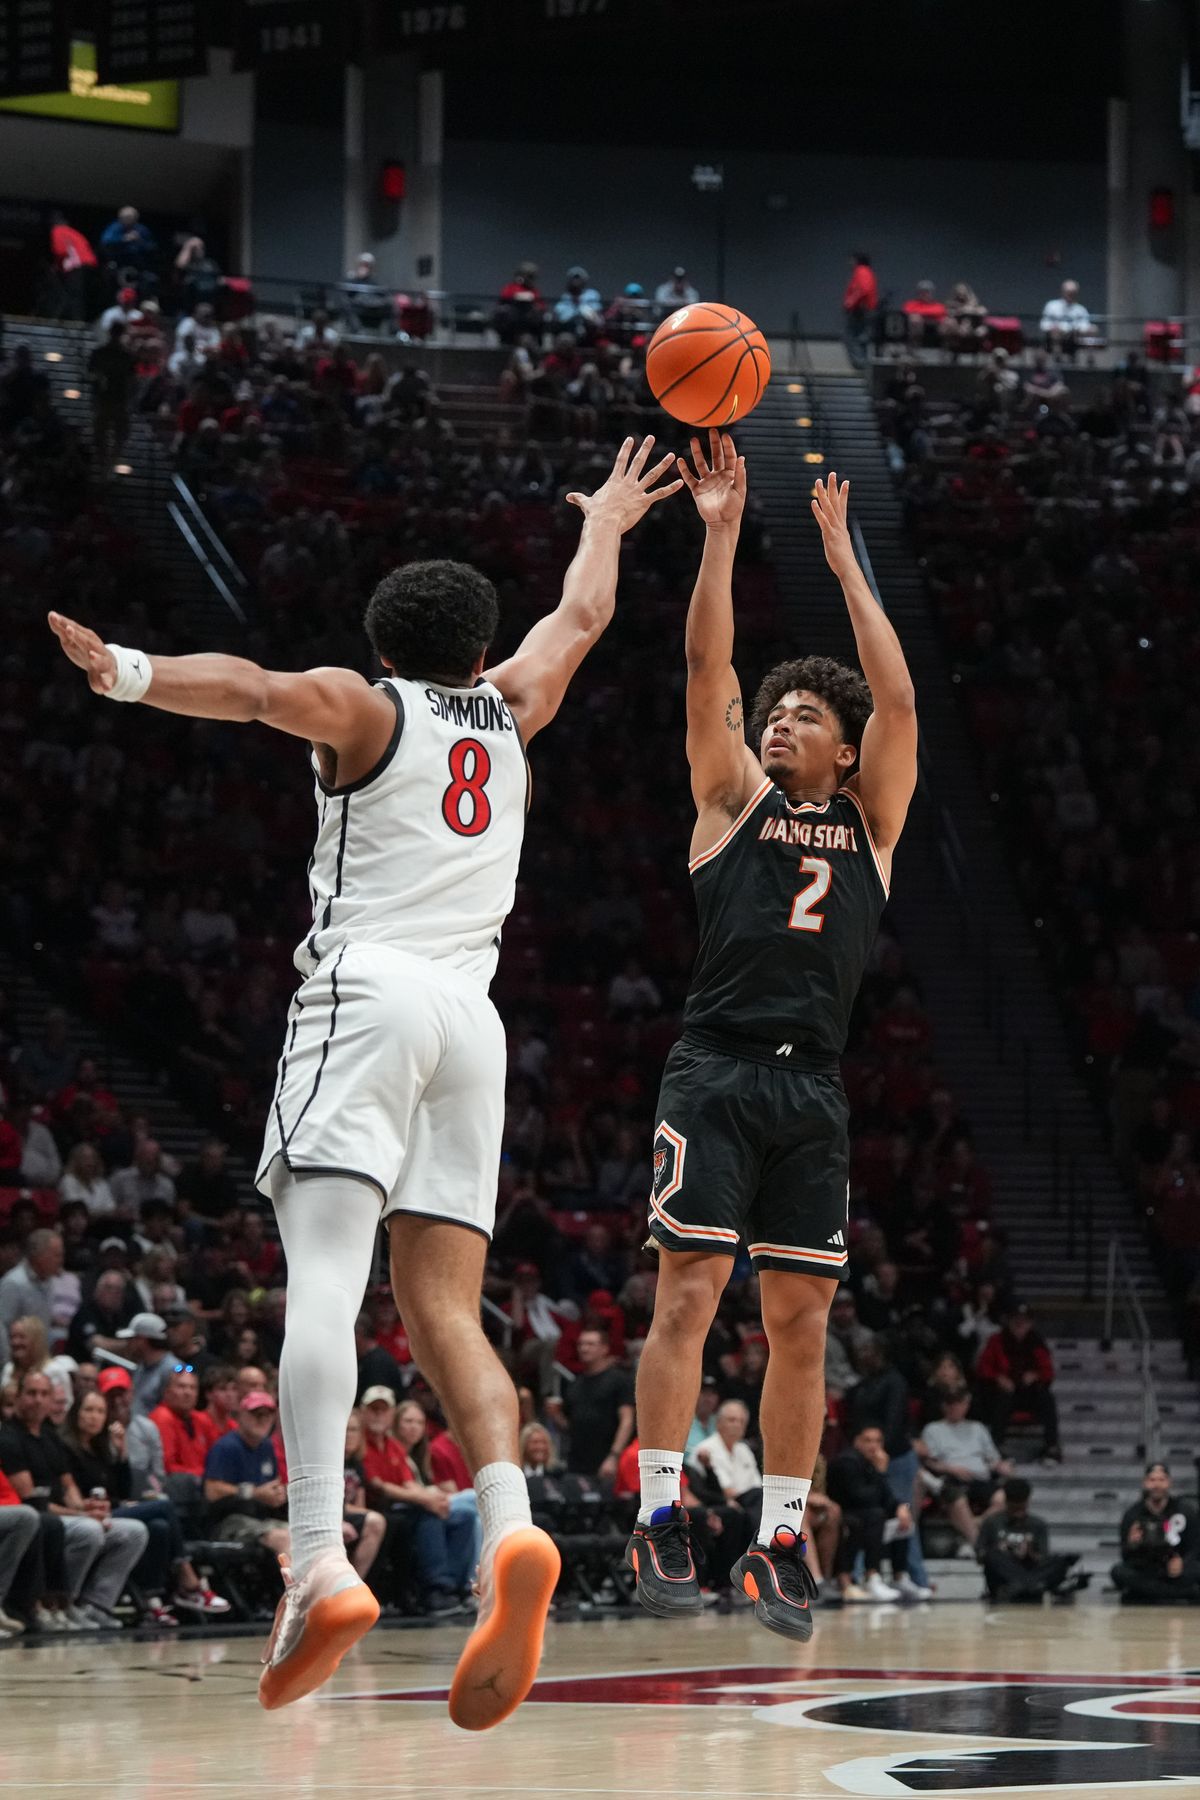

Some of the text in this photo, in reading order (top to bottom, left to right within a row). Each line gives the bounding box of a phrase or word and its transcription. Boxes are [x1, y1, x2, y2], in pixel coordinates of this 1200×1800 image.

[425, 688, 513, 732] SIMMONS
[441, 737, 492, 838] 8
[788, 855, 833, 933] 2
